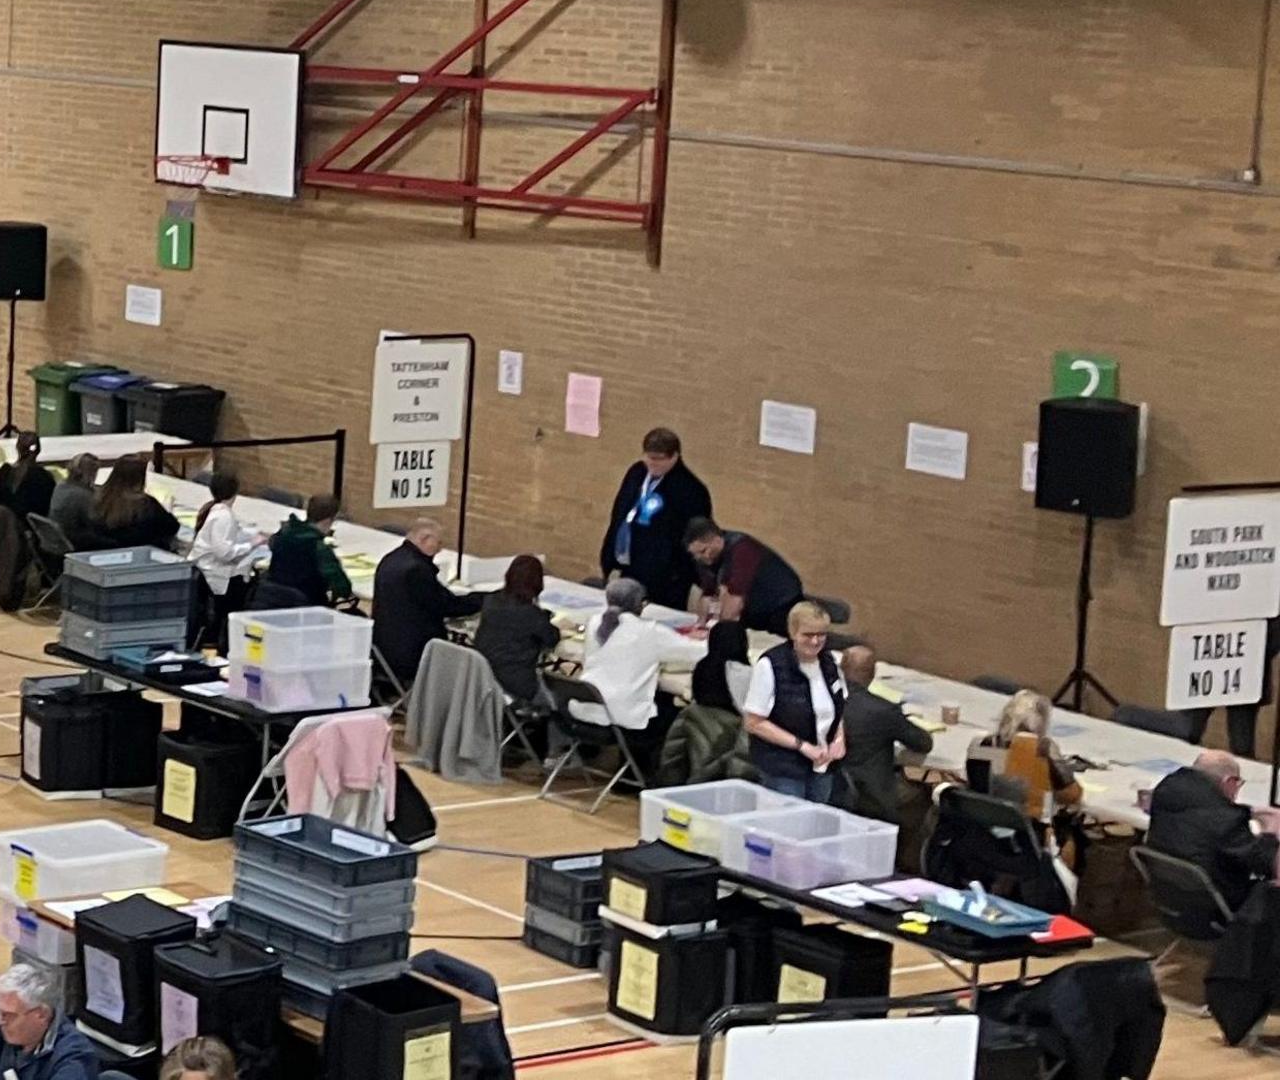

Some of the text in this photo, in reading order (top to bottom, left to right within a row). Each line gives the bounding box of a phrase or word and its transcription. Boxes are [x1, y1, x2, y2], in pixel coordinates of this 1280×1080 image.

[165, 224, 178, 265] 1
[391, 360, 450, 373] TATTENHAM
[397, 377, 440, 390] CORNER
[413, 395, 421, 407] &
[392, 411, 440, 424] PRESTON
[393, 449, 435, 471] TABLE
[390, 477, 432, 499] NO 15
[1189, 524, 1264, 546] SOUTH PARK
[1174, 552, 1200, 570] AND
[1207, 573, 1242, 591] WARD
[1192, 631, 1247, 661] TABLE
[1188, 667, 1242, 697] NO 14
